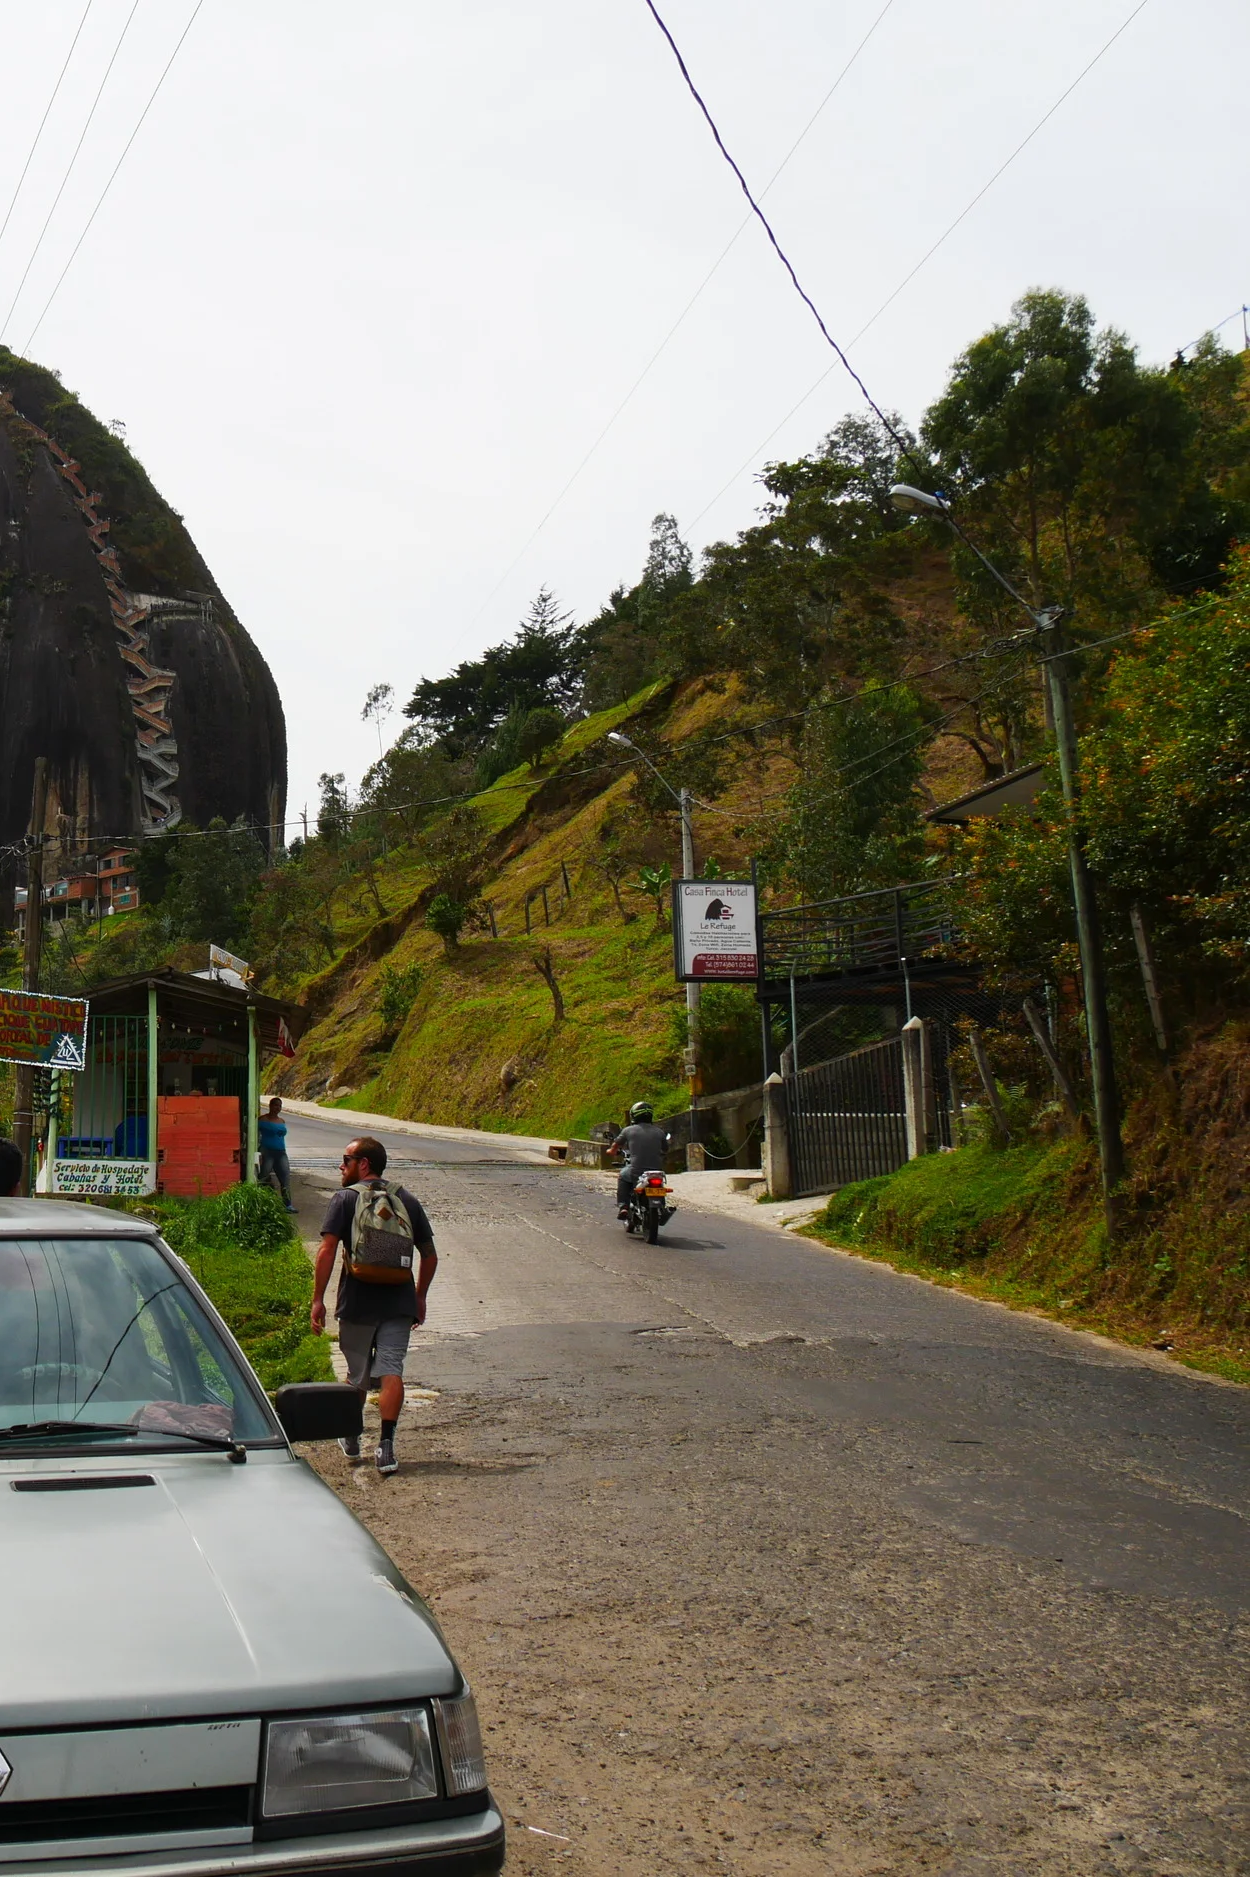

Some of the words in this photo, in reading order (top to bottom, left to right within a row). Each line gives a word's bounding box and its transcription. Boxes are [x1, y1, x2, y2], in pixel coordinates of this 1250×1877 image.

[684, 886, 703, 896] Casa
[705, 886, 725, 897] Finca
[726, 887, 748, 897] Hotel
[700, 922, 709, 930] Le
[710, 922, 736, 931] Refuge
[54, 1162, 90, 1173] Servicio
[101, 1164, 149, 1177] Hospedaje
